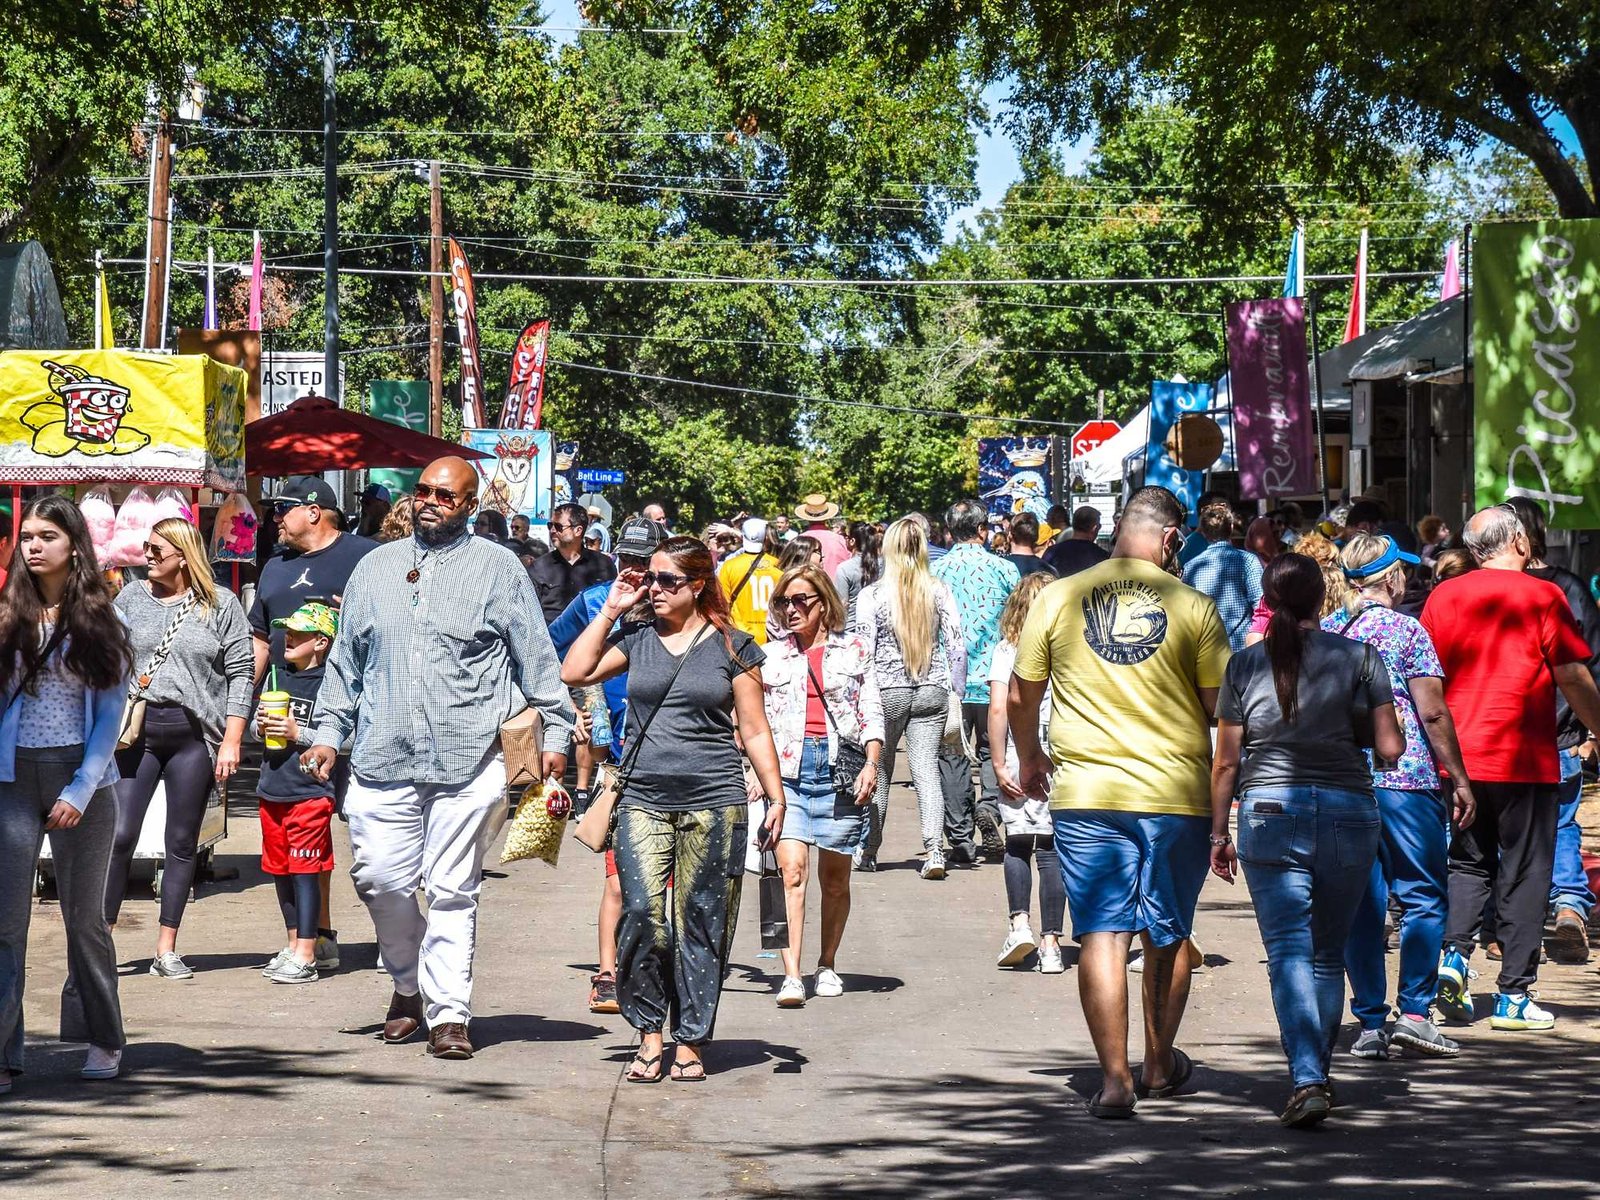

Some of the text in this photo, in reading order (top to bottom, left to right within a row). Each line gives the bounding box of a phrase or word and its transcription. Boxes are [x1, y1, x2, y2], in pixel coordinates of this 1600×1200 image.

[262, 370, 322, 386] ASTED
[262, 402, 285, 413] CNS
[1075, 439, 1101, 458] ST
[578, 471, 594, 481] Belt
[595, 472, 612, 481] Line
[750, 575, 775, 612] 10
[1137, 582, 1162, 604] BEACH
[1127, 647, 1150, 662] CLUB
